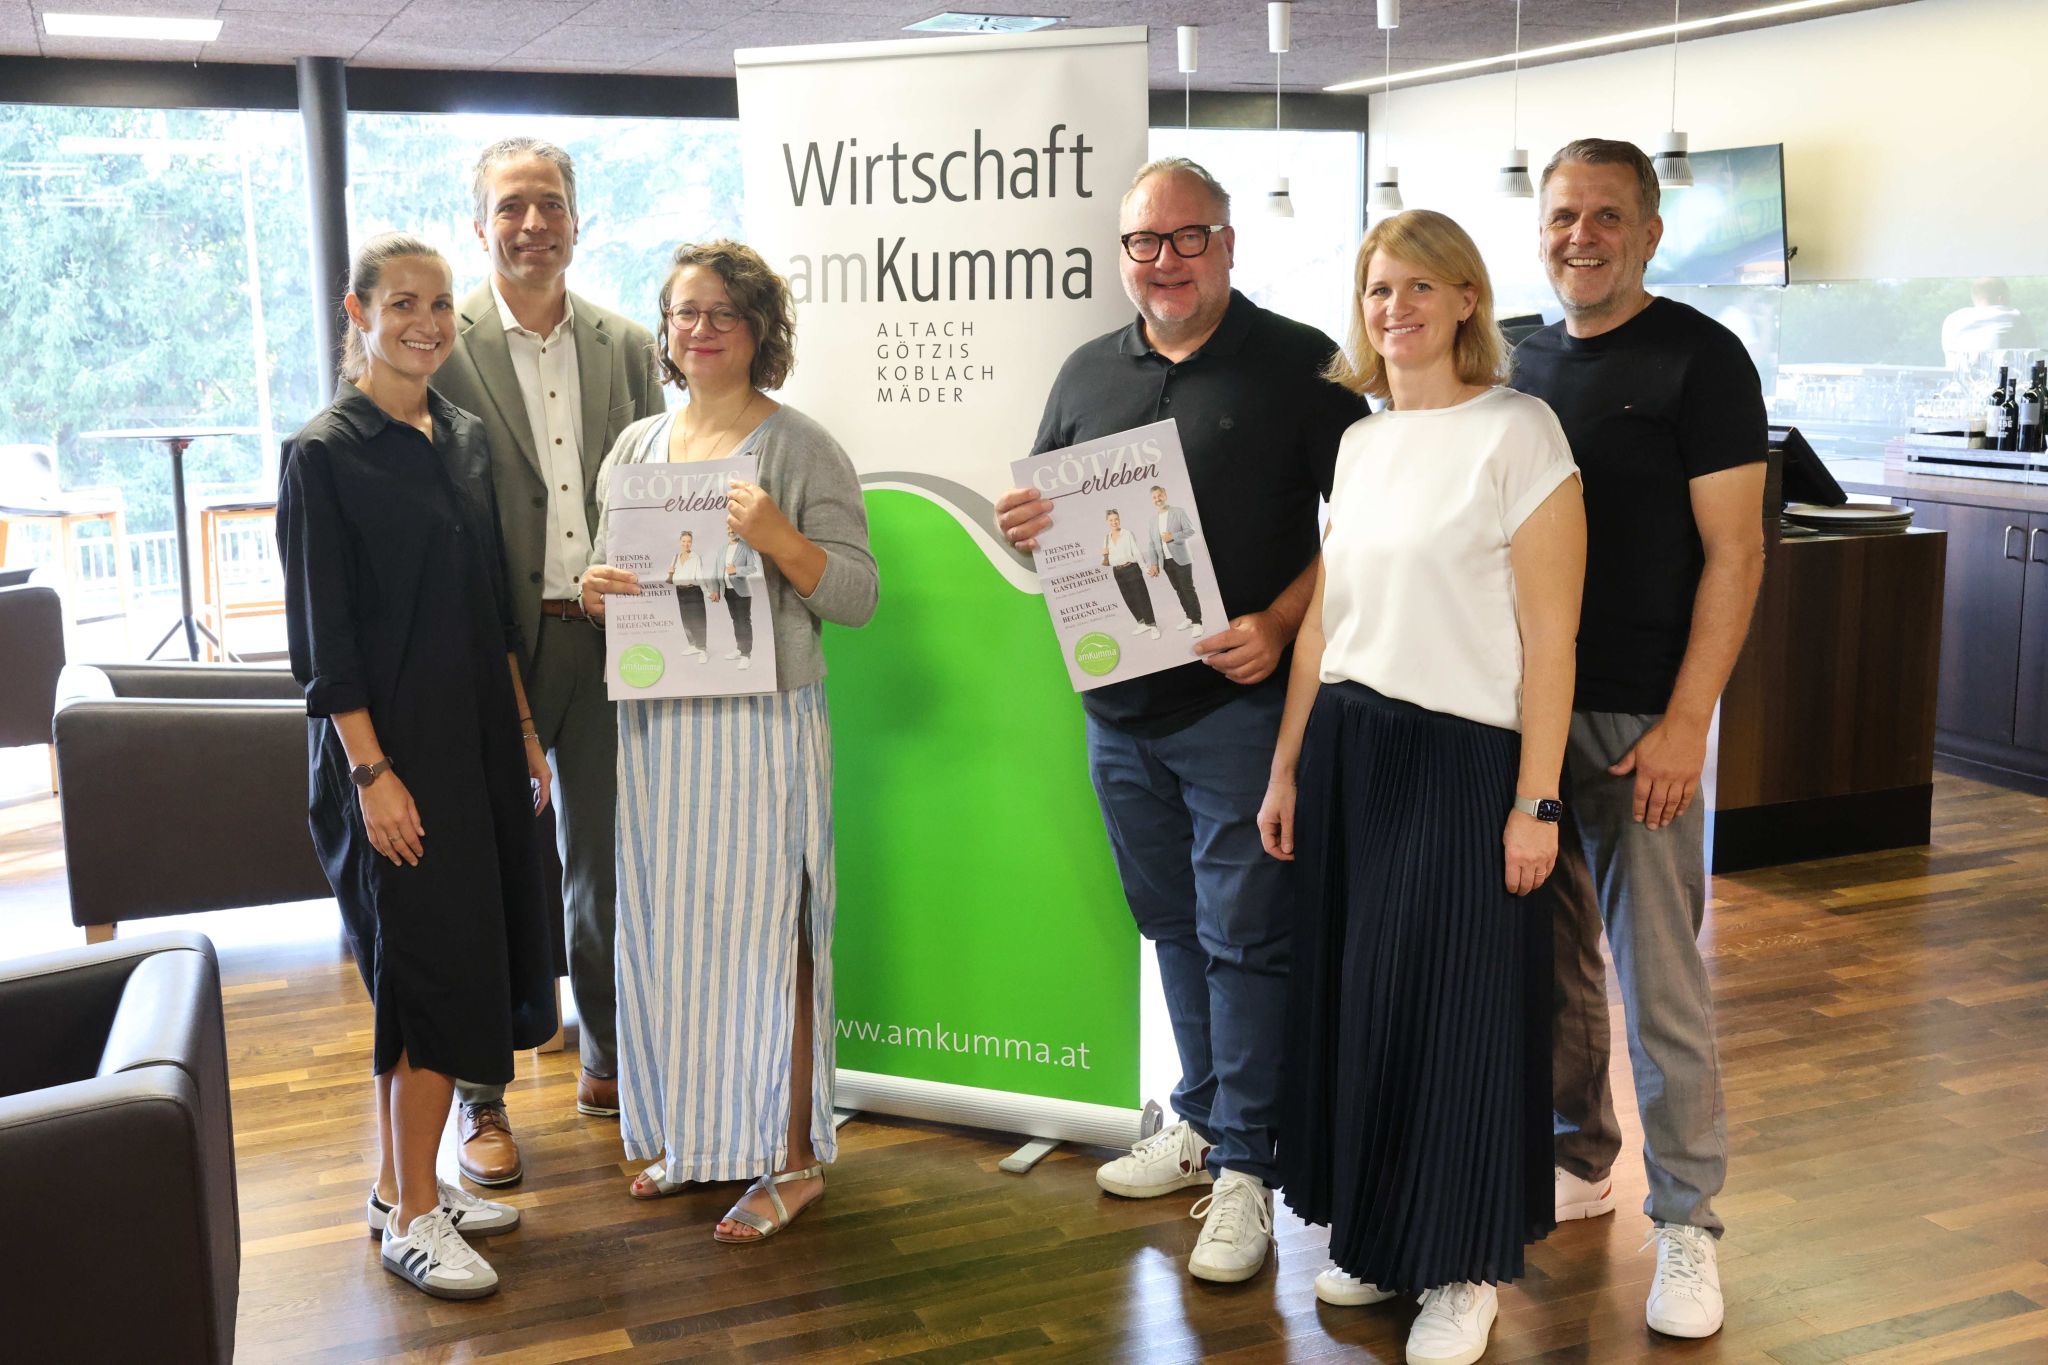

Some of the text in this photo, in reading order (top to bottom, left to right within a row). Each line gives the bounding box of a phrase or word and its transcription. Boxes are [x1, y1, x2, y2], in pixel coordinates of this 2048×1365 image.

[782, 124, 1093, 207] Wirtschaft
[789, 236, 1093, 304] amKumma
[877, 321, 975, 337] ALTACH
[877, 341, 969, 360] GÖTZIS
[877, 365, 994, 381] KOBLACH
[877, 385, 965, 403] MÄDER
[1032, 438, 1163, 492] GÖTZIS
[1081, 463, 1159, 495] erleben
[615, 554, 643, 562] TRENDS
[1044, 544, 1074, 556] TRENDS
[1046, 549, 1085, 564] LIFESTYLE
[1051, 570, 1094, 586] KULINARIK
[1053, 573, 1109, 593] GASTLICHKEIT
[1060, 603, 1091, 616] KULTUR
[1062, 602, 1119, 623] BEGEGNUNGEN
[616, 620, 674, 629] BEGEGNUNGEN
[834, 1019, 1091, 1070] ww.amkumma.at
